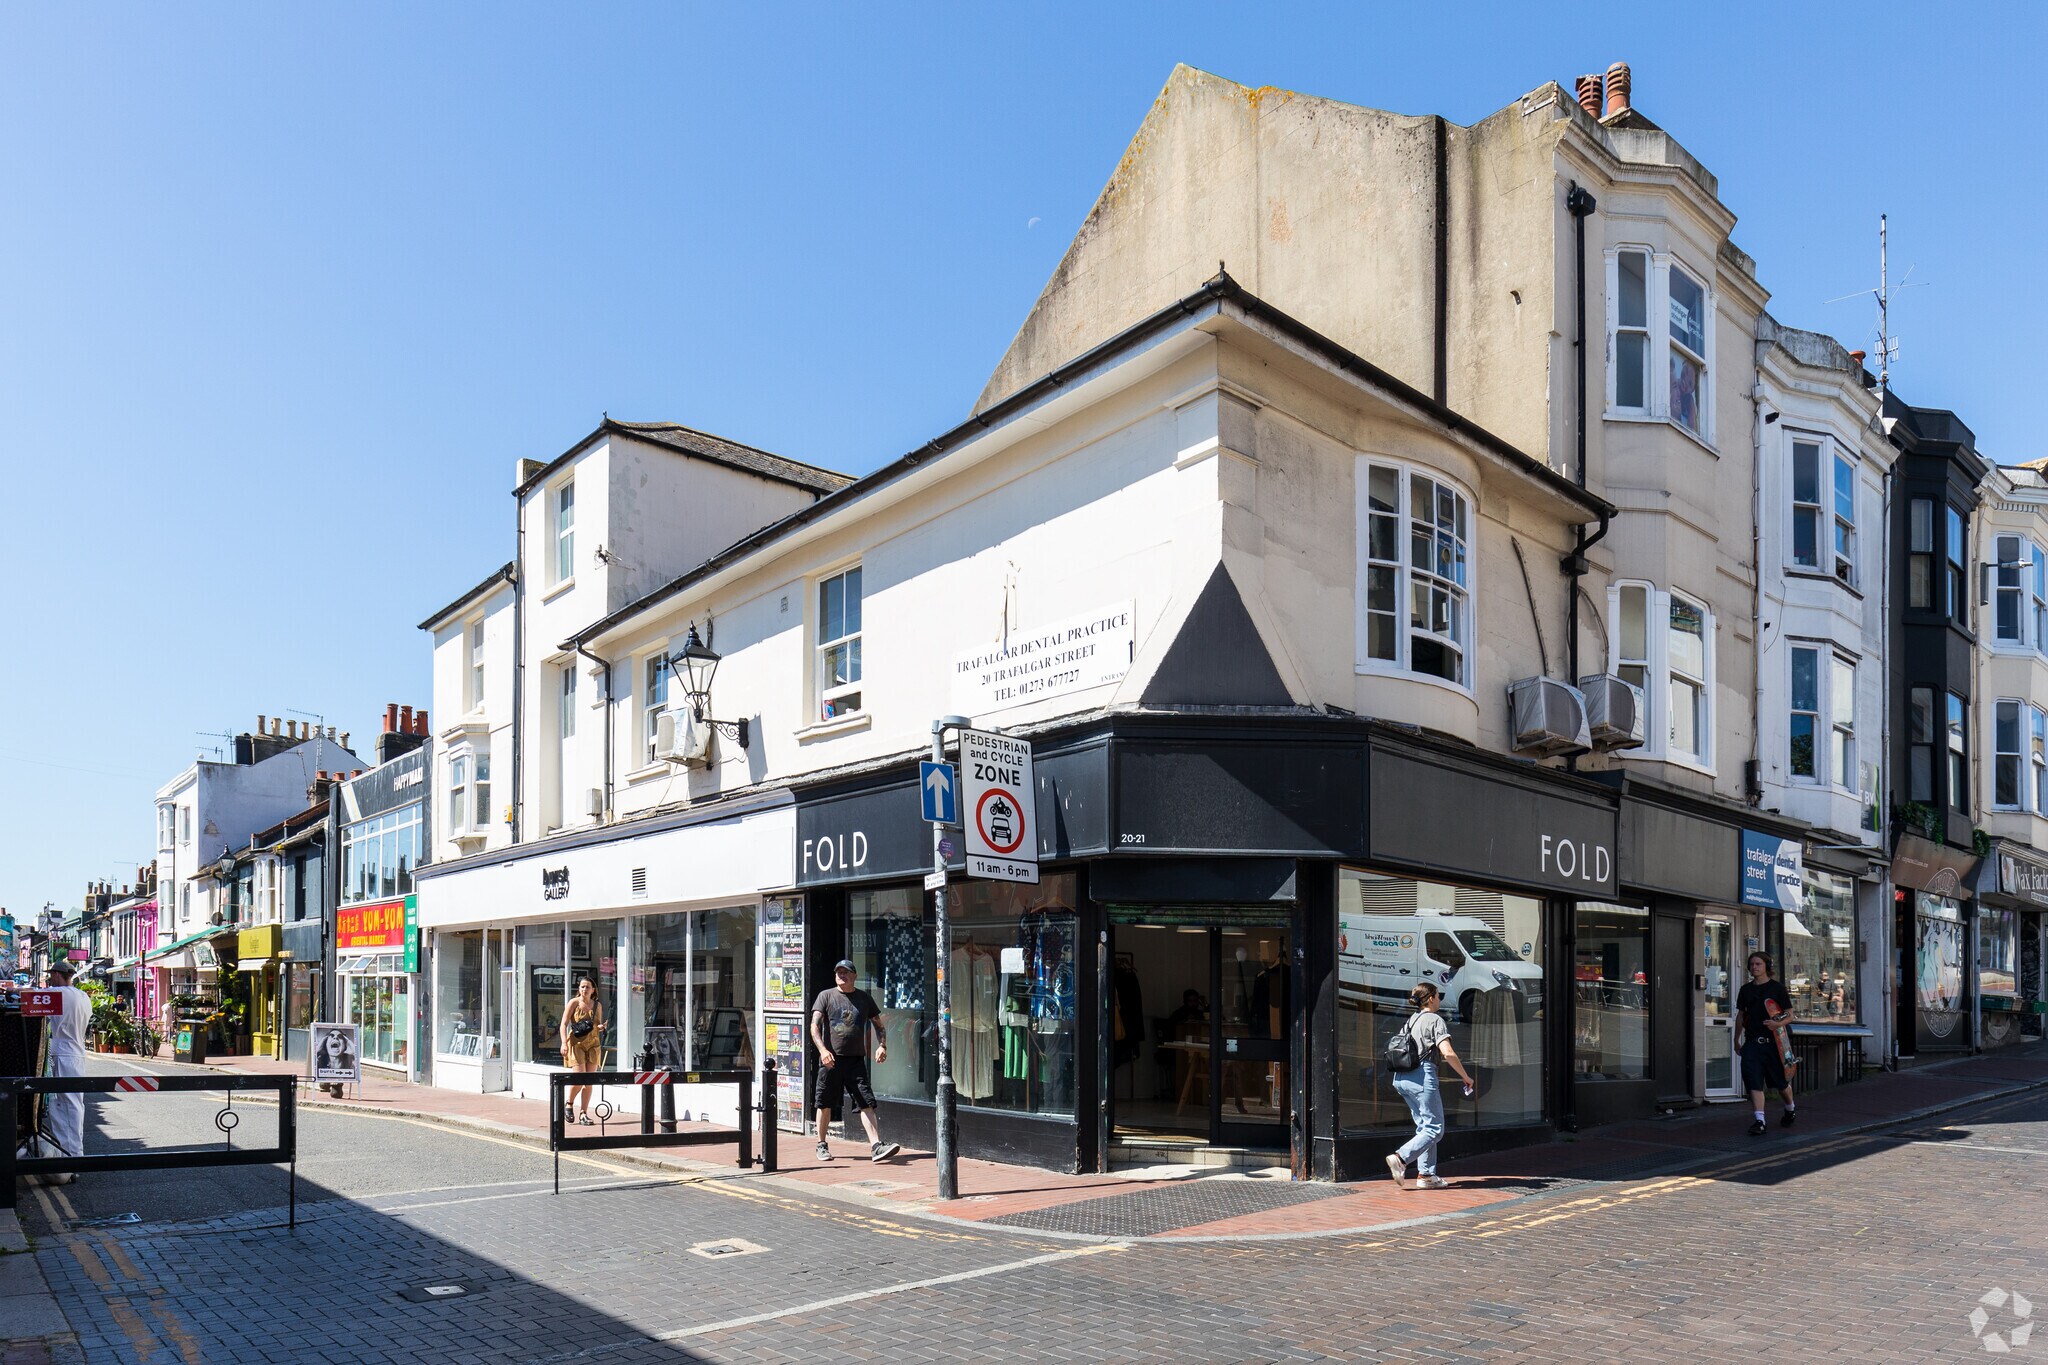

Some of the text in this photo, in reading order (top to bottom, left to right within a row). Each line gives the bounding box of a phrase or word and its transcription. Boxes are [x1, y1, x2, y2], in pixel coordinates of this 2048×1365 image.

[956, 612, 1129, 674] TRAFALGAR DENTAL PRACTICE
[981, 643, 1097, 686] 20 TRAFALGAR STREET
[994, 669, 1081, 702] TEL: 01273 677727
[1101, 671, 1126, 682] ENTRAN
[963, 732, 1029, 755] PEDESTRIAN
[970, 748, 1024, 767] and CYCLE
[974, 763, 1021, 787] ZONE
[1121, 833, 1145, 843] 20-21
[803, 831, 868, 874] FOLD
[1541, 834, 1610, 883] FOLD
[1746, 847, 1796, 870] trafalgar dental
[976, 861, 985, 873] 11
[986, 864, 1001, 874] am
[1007, 864, 1014, 876] 6
[1015, 866, 1030, 878] pm
[1746, 865, 1801, 888] street practice
[2014, 865, 2031, 890] Wax
[544, 886, 570, 901] GALLERY
[33, 995, 51, 1005] £8
